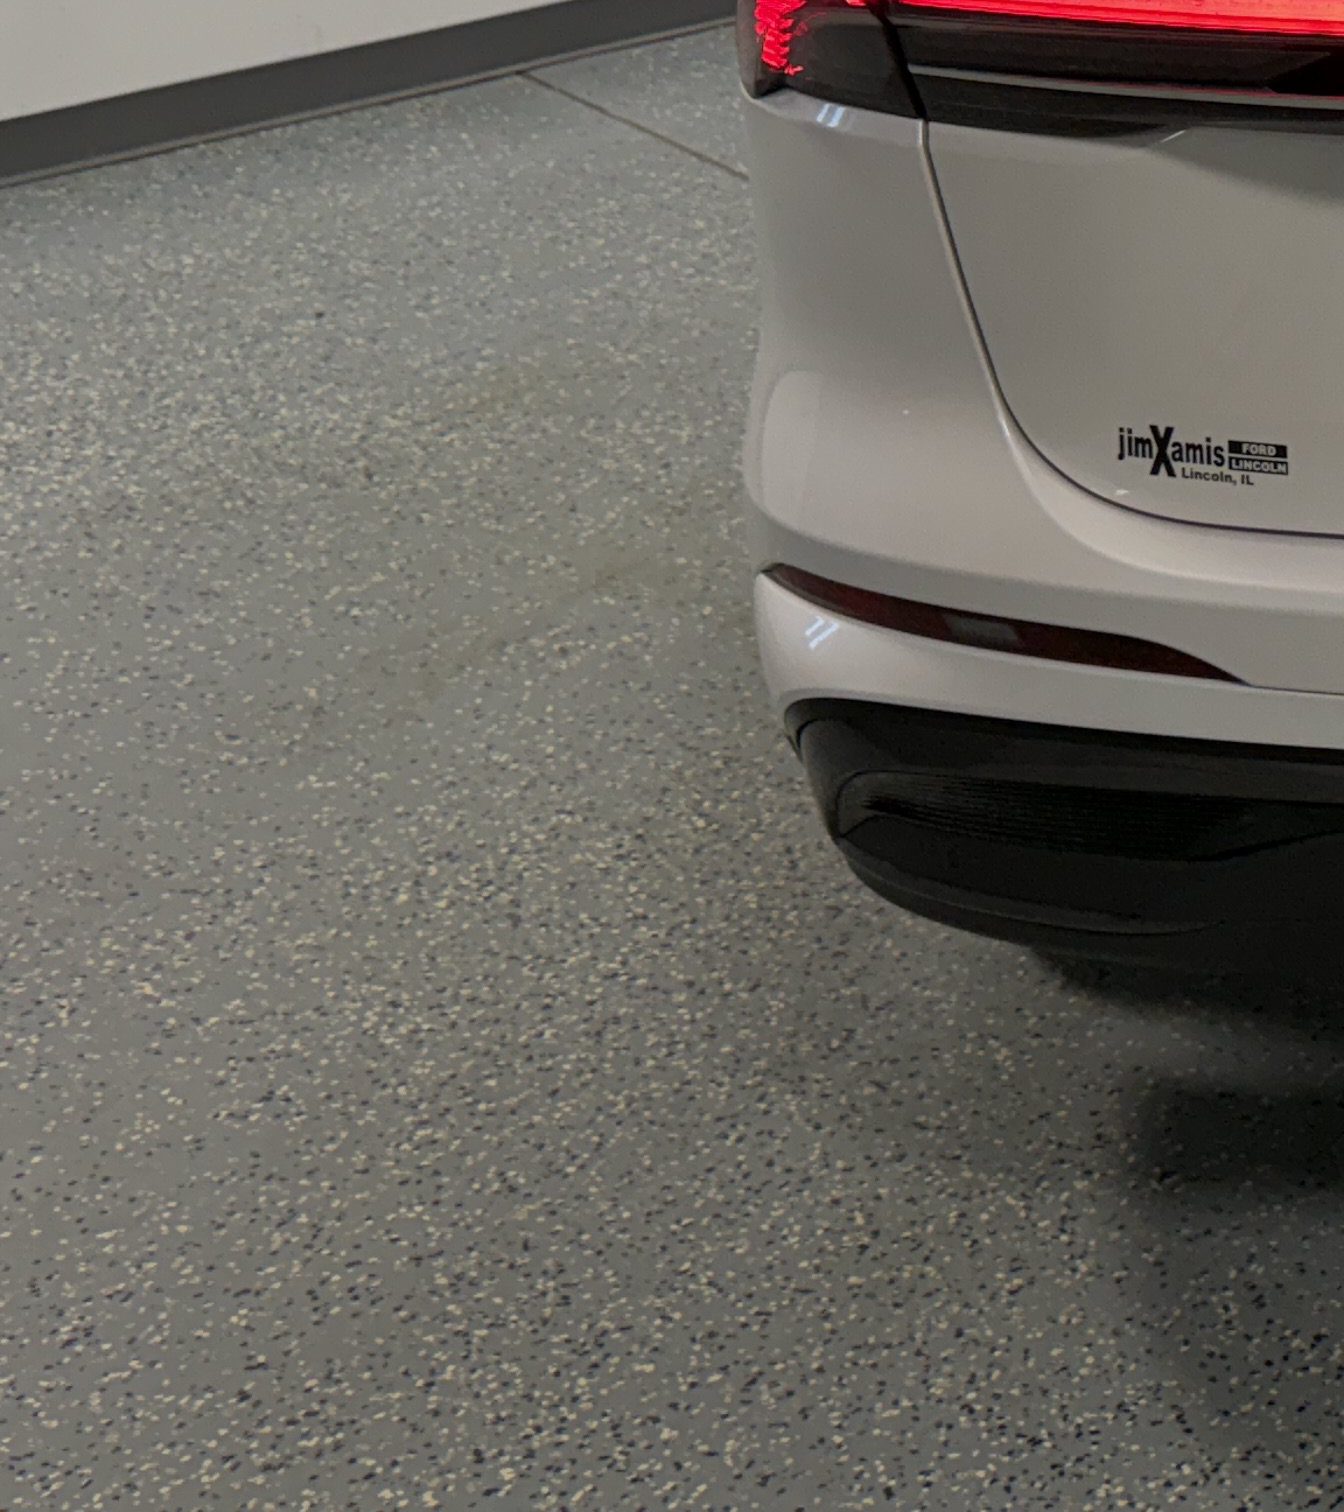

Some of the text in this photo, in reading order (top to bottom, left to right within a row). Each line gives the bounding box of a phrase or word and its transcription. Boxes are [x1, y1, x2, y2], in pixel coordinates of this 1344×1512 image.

[1242, 444, 1276, 456] FORD
[1231, 458, 1287, 474] LINCOLN
[1181, 467, 1255, 486] Lincoln, IL
